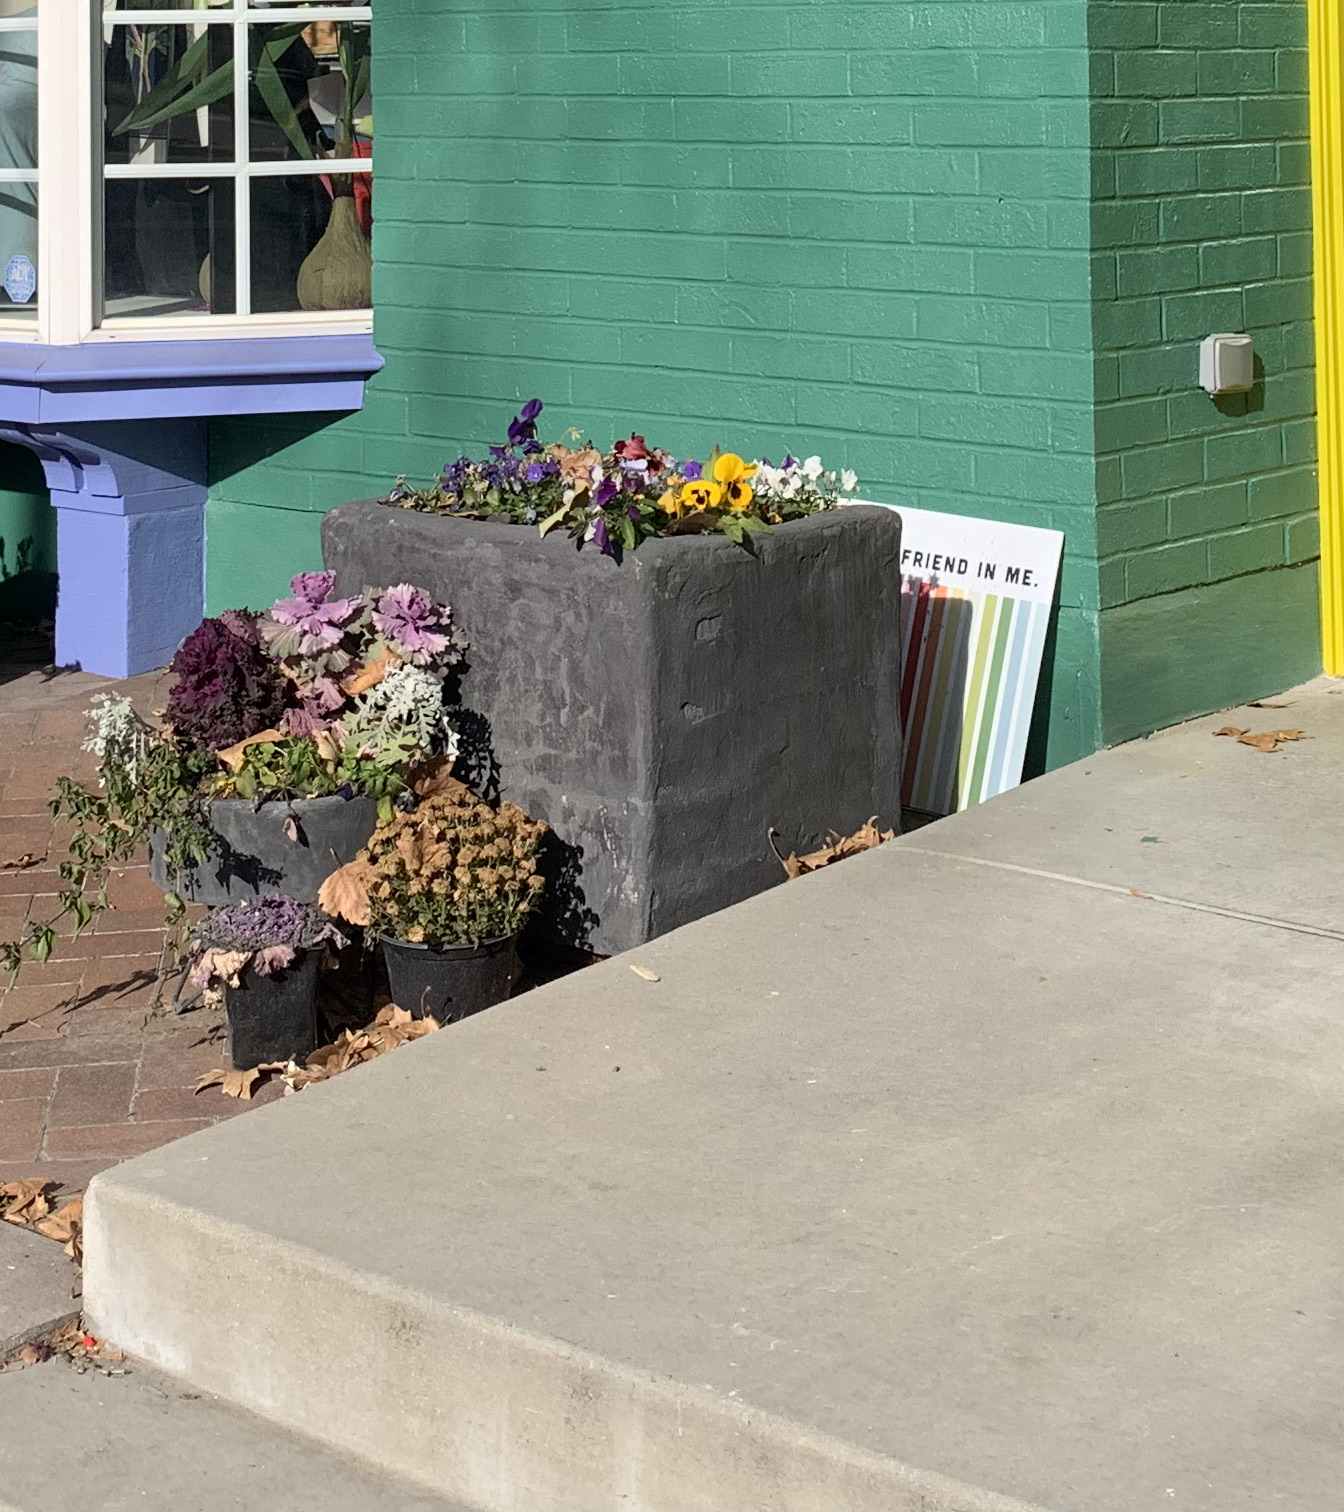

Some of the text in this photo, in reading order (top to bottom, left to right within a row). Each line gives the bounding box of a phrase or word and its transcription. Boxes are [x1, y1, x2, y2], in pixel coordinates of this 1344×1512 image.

[901, 549, 1039, 588] FRIEND IN ME.
